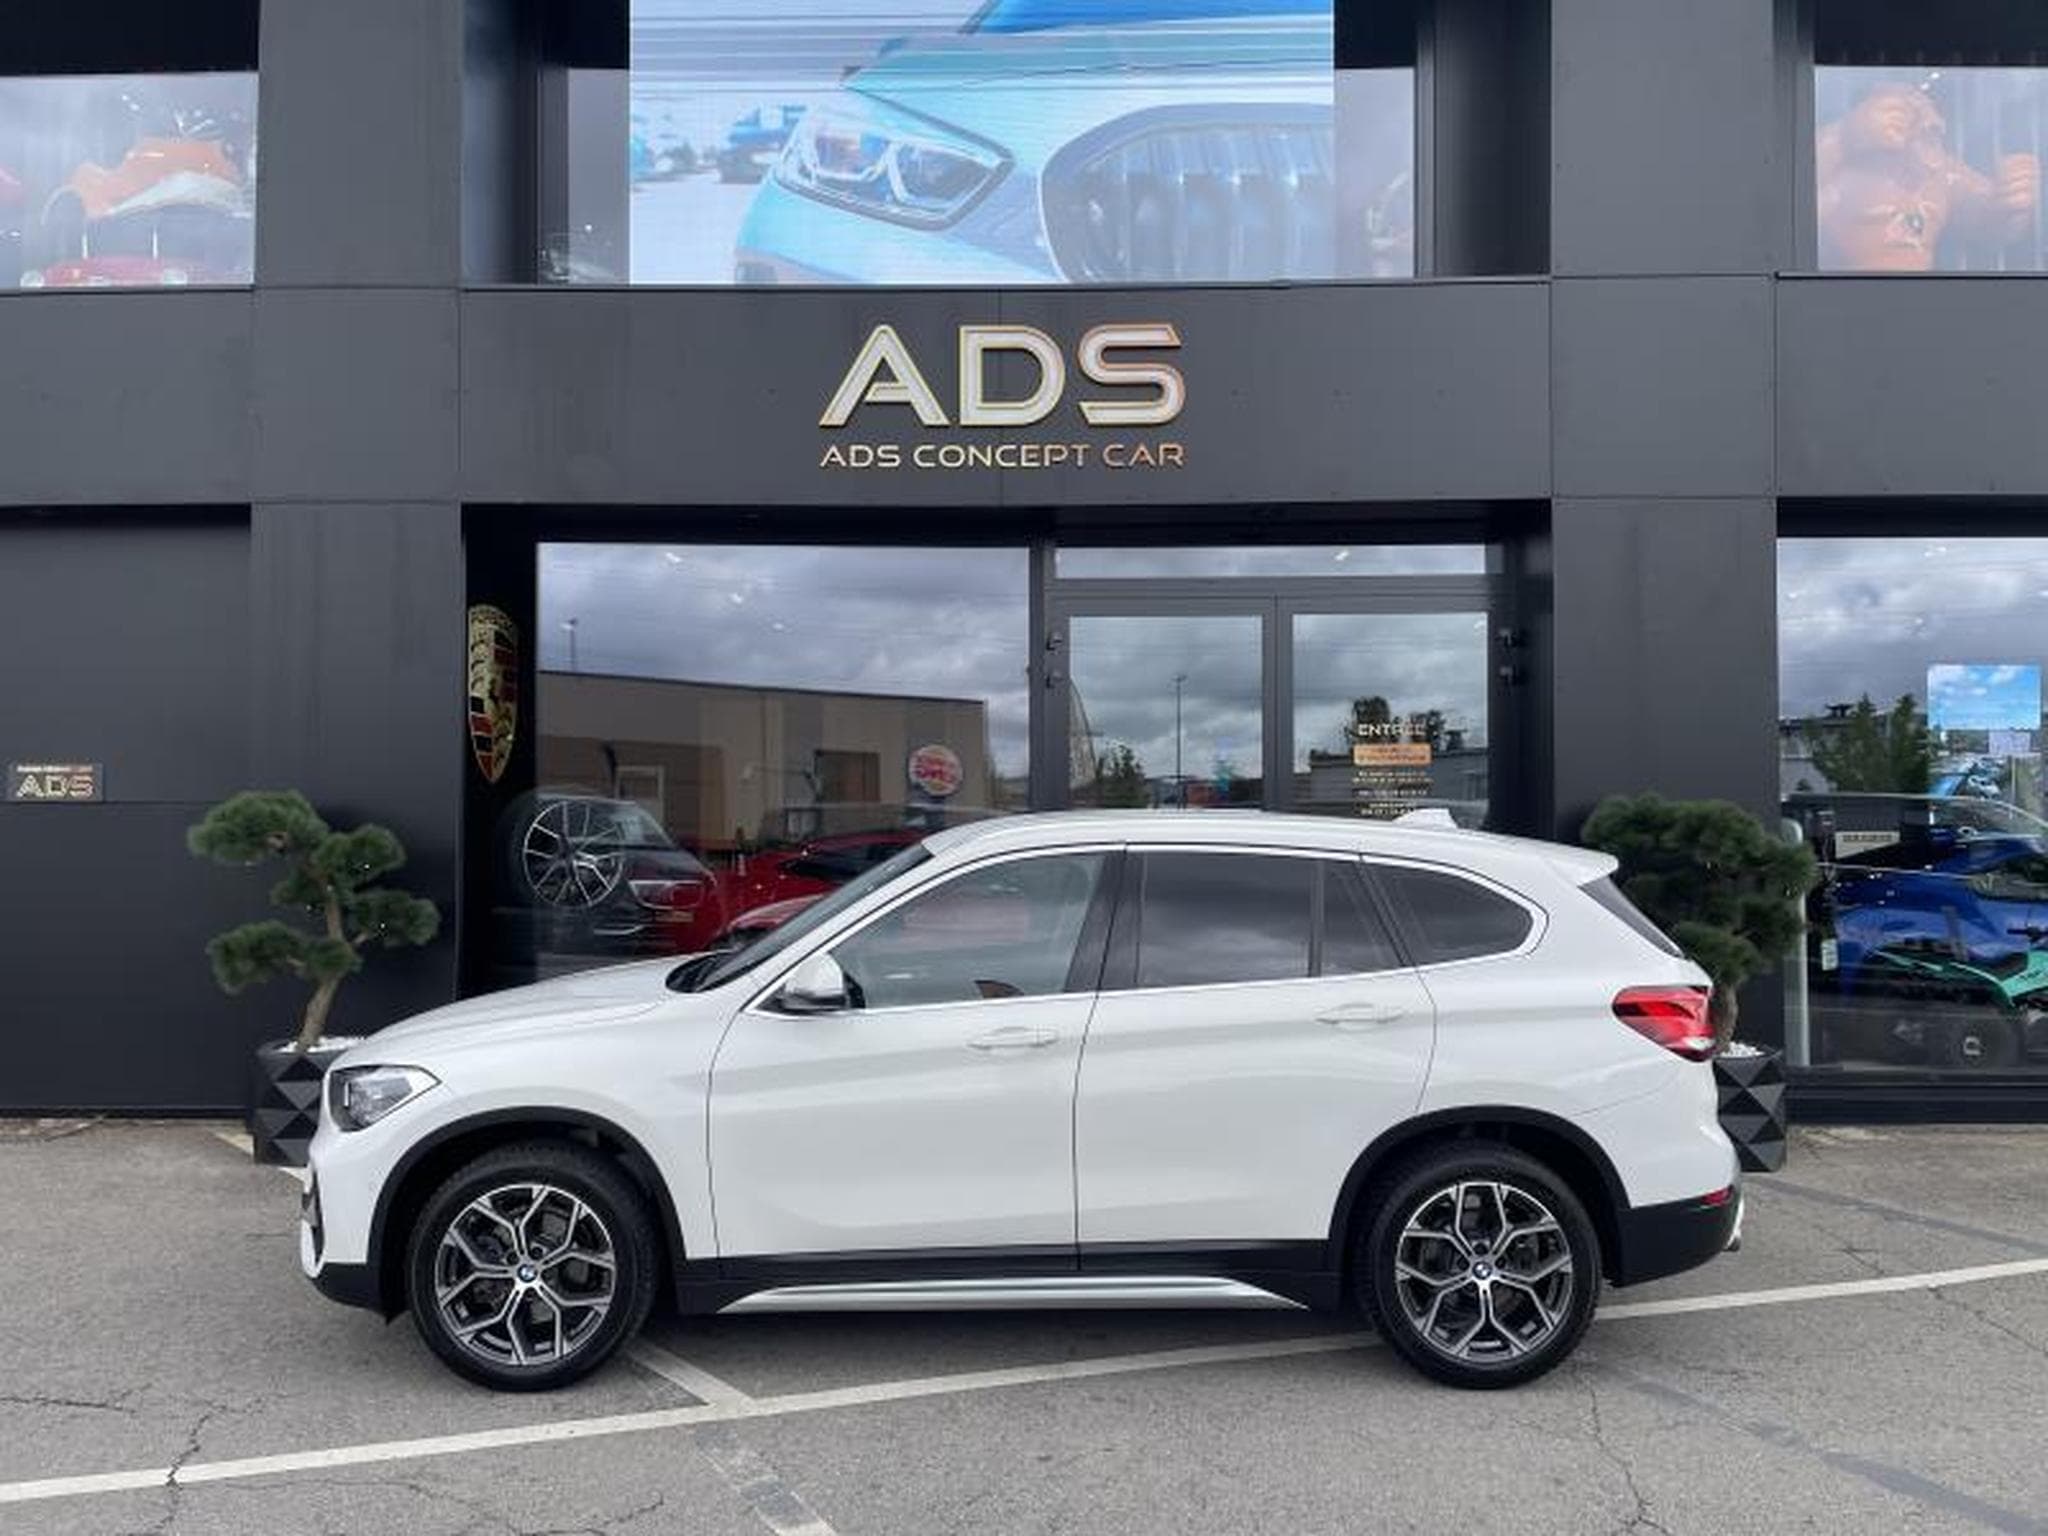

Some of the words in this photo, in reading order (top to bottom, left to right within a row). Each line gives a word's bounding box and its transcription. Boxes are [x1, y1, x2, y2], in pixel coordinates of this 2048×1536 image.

[818, 323, 1187, 427] ADS
[819, 443, 900, 468] ADS
[913, 443, 1091, 468] CONCEPT
[1102, 442, 1184, 468] CAR
[16, 774, 94, 798] ADS
